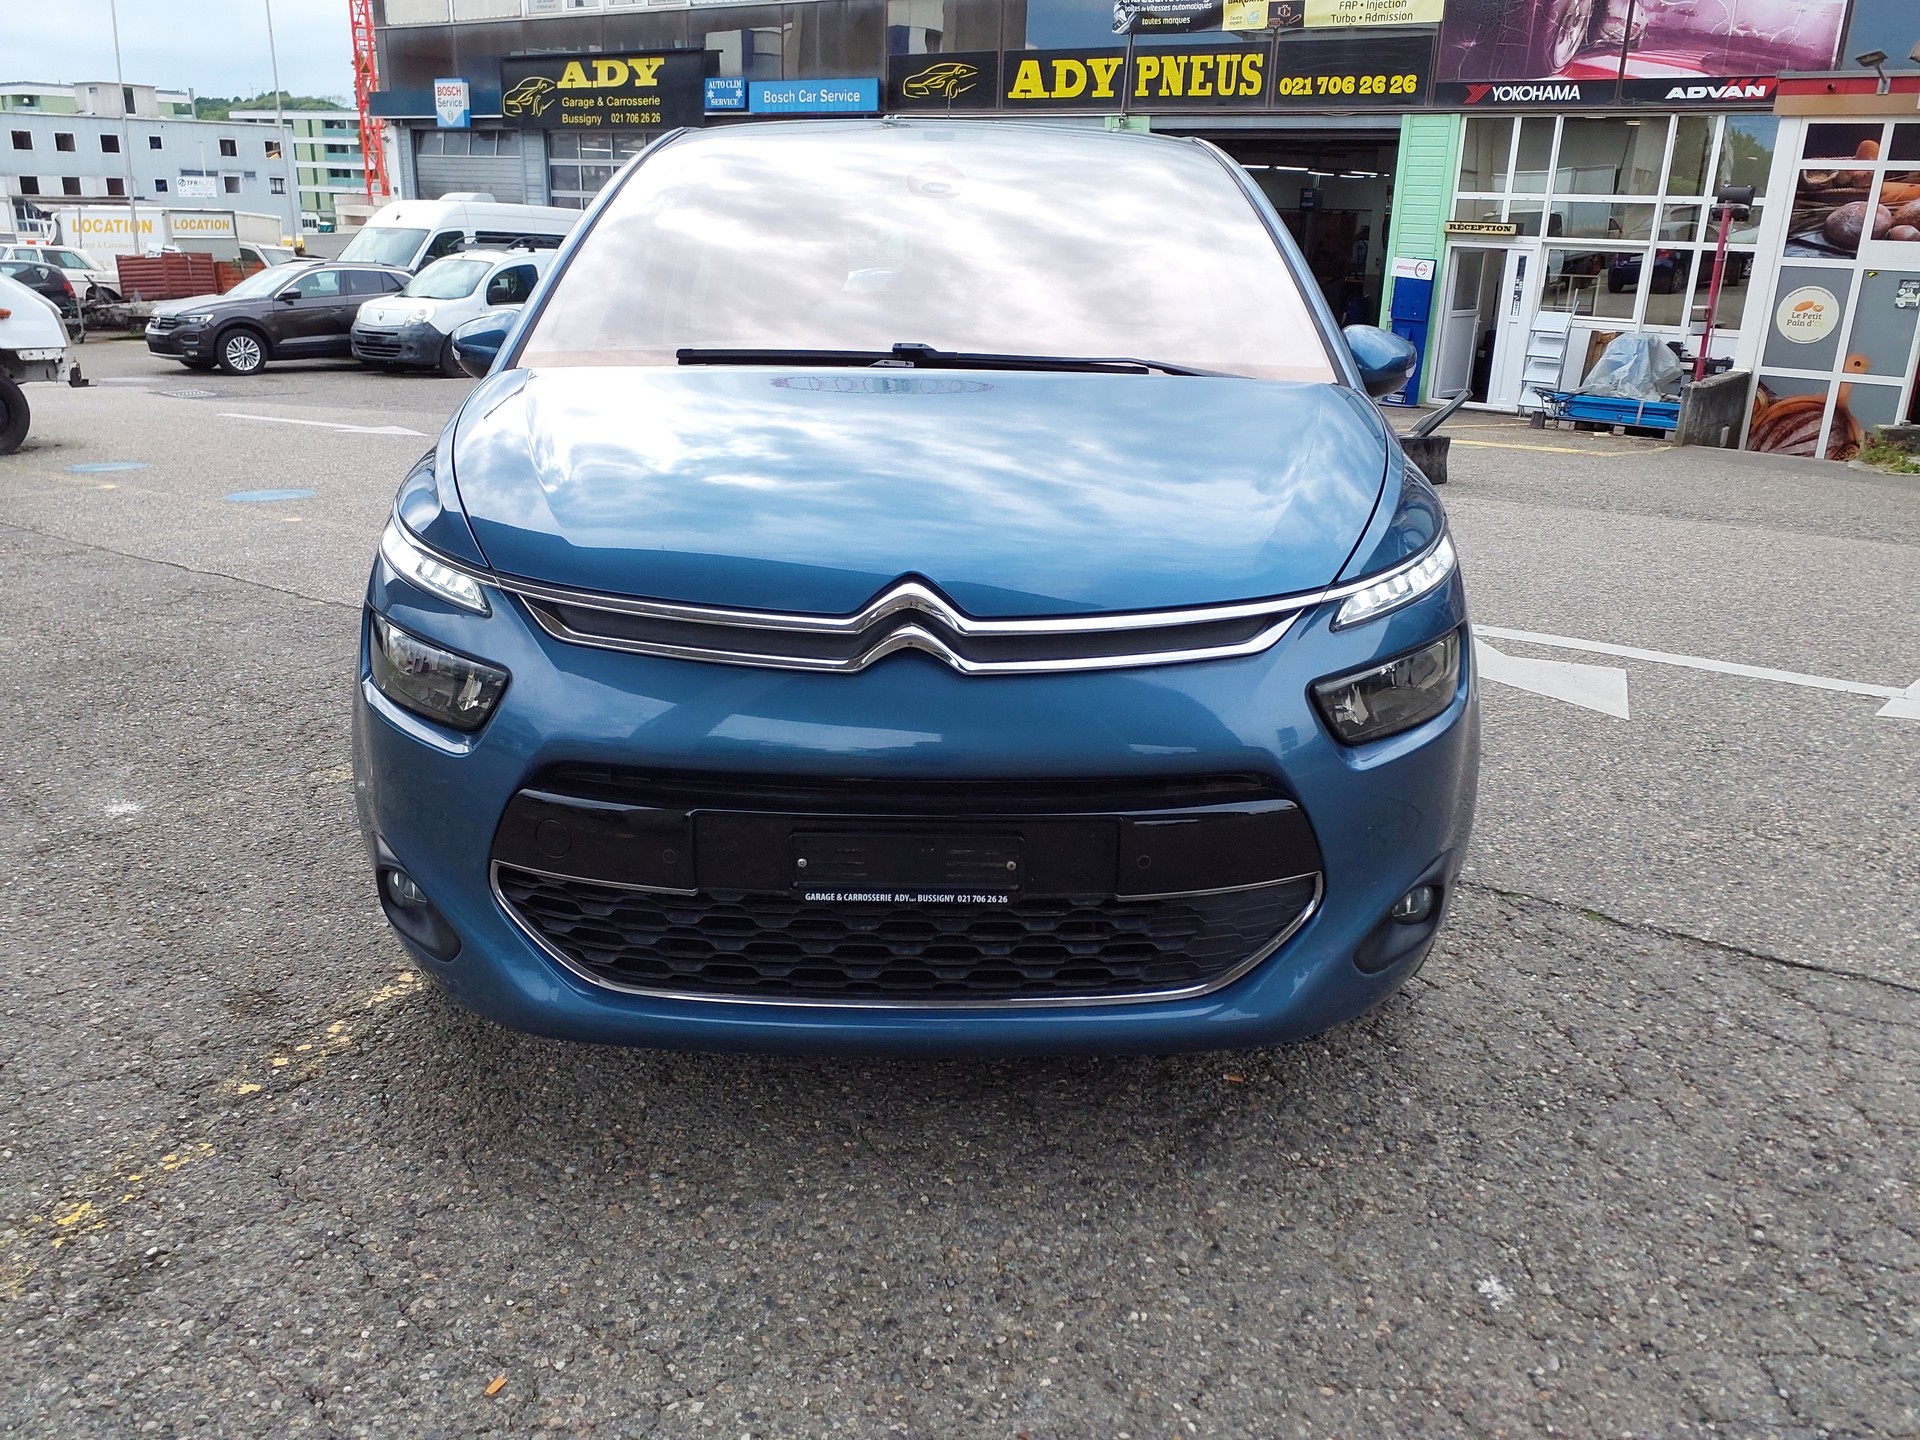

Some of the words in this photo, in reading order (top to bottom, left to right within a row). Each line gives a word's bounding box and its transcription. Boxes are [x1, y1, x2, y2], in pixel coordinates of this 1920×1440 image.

[1147, 4, 1171, 12] vitesses
[1171, 2, 1213, 11] automatiques
[1339, 2, 1357, 10] FAP
[1366, 0, 1407, 11] Injection
[1142, 17, 1161, 26] toutes
[1162, 17, 1191, 25] marques
[1331, 14, 1356, 24] Turbo
[1365, 12, 1413, 23] Admission
[556, 57, 665, 89] ADY
[1008, 57, 1124, 100] ADY
[1134, 53, 1264, 97] PNEUS
[708, 81, 725, 89] AUTO
[725, 80, 742, 89] CLIM
[1279, 76, 1313, 96] 021
[1317, 75, 1356, 95] 706
[1358, 75, 1387, 95] 26
[1389, 74, 1418, 94] 26
[437, 86, 462, 97] BOSCH
[763, 90, 796, 103] Bosch
[798, 90, 817, 102] Car
[819, 89, 861, 102] Service
[1492, 85, 1580, 102] YOKOHAMA
[1664, 85, 1766, 99] ADVAN
[437, 96, 463, 108] Service
[562, 97, 595, 109] Garage
[597, 97, 604, 107] &
[606, 95, 661, 106] Carrosserie
[562, 113, 602, 126] Bussigny
[610, 113, 624, 123] 021
[625, 113, 640, 123] 706
[640, 113, 650, 123] 26
[651, 112, 661, 123] 26
[173, 219, 230, 231] LOCATION
[1448, 222, 1512, 232] RÉCEPTION
[805, 893, 835, 901] GARAGE
[836, 893, 842, 901] &
[843, 893, 892, 902] CARROSSERIE
[894, 894, 909, 902] ADY
[917, 894, 955, 903] BUSSIGNY
[957, 895, 971, 903] 021
[972, 895, 986, 903] 706
[987, 895, 997, 903] 26
[998, 895, 1008, 904] 26
